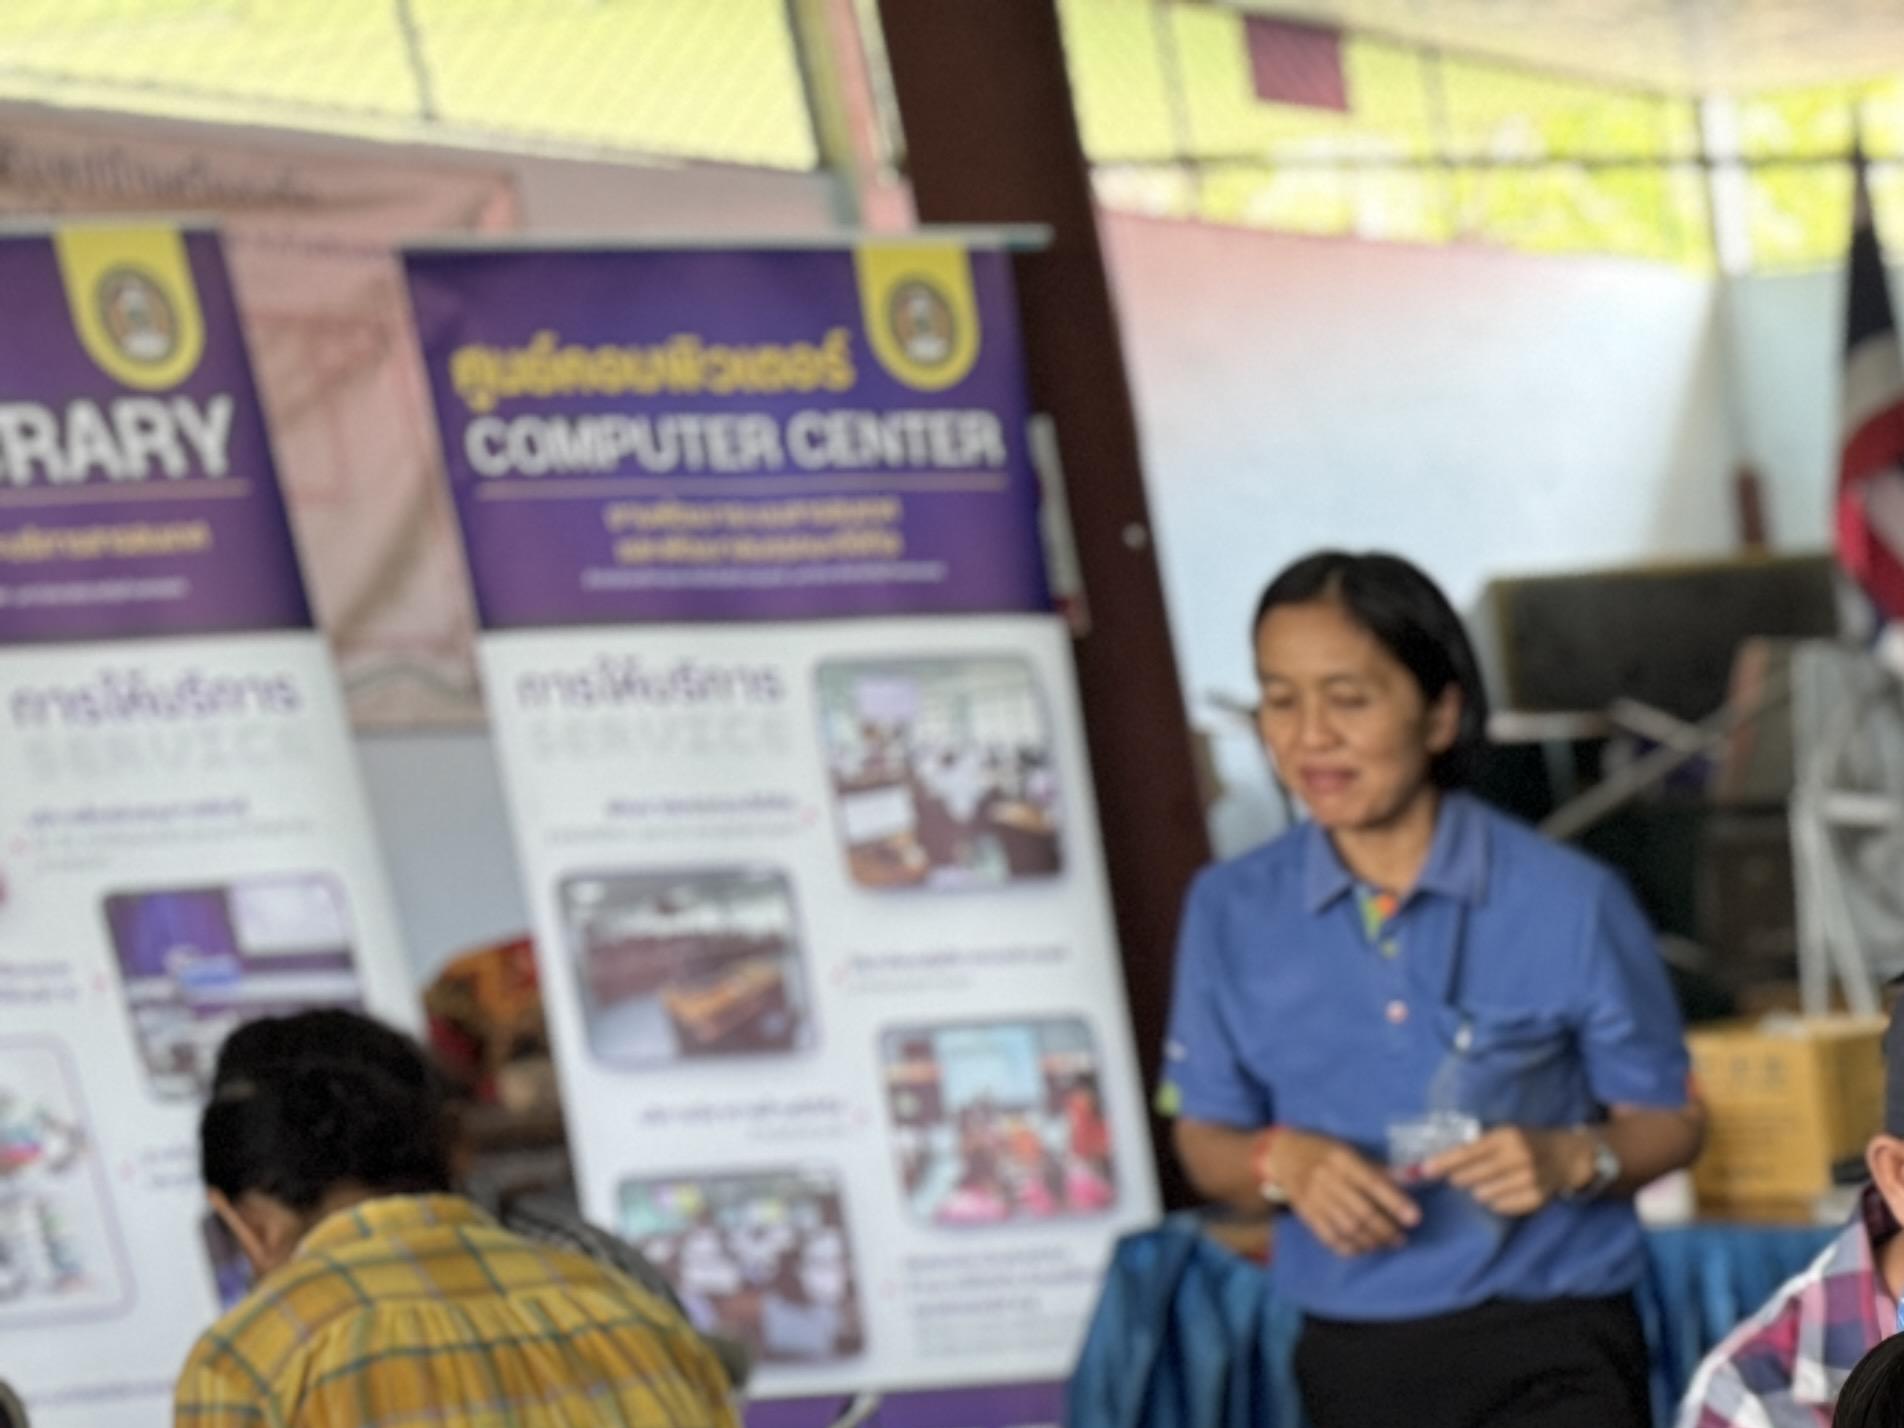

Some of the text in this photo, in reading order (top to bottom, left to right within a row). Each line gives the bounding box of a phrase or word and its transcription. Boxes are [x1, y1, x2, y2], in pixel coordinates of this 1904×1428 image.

[0, 394, 234, 486] RARY
[464, 408, 1008, 477] COMPUTER CENTER
